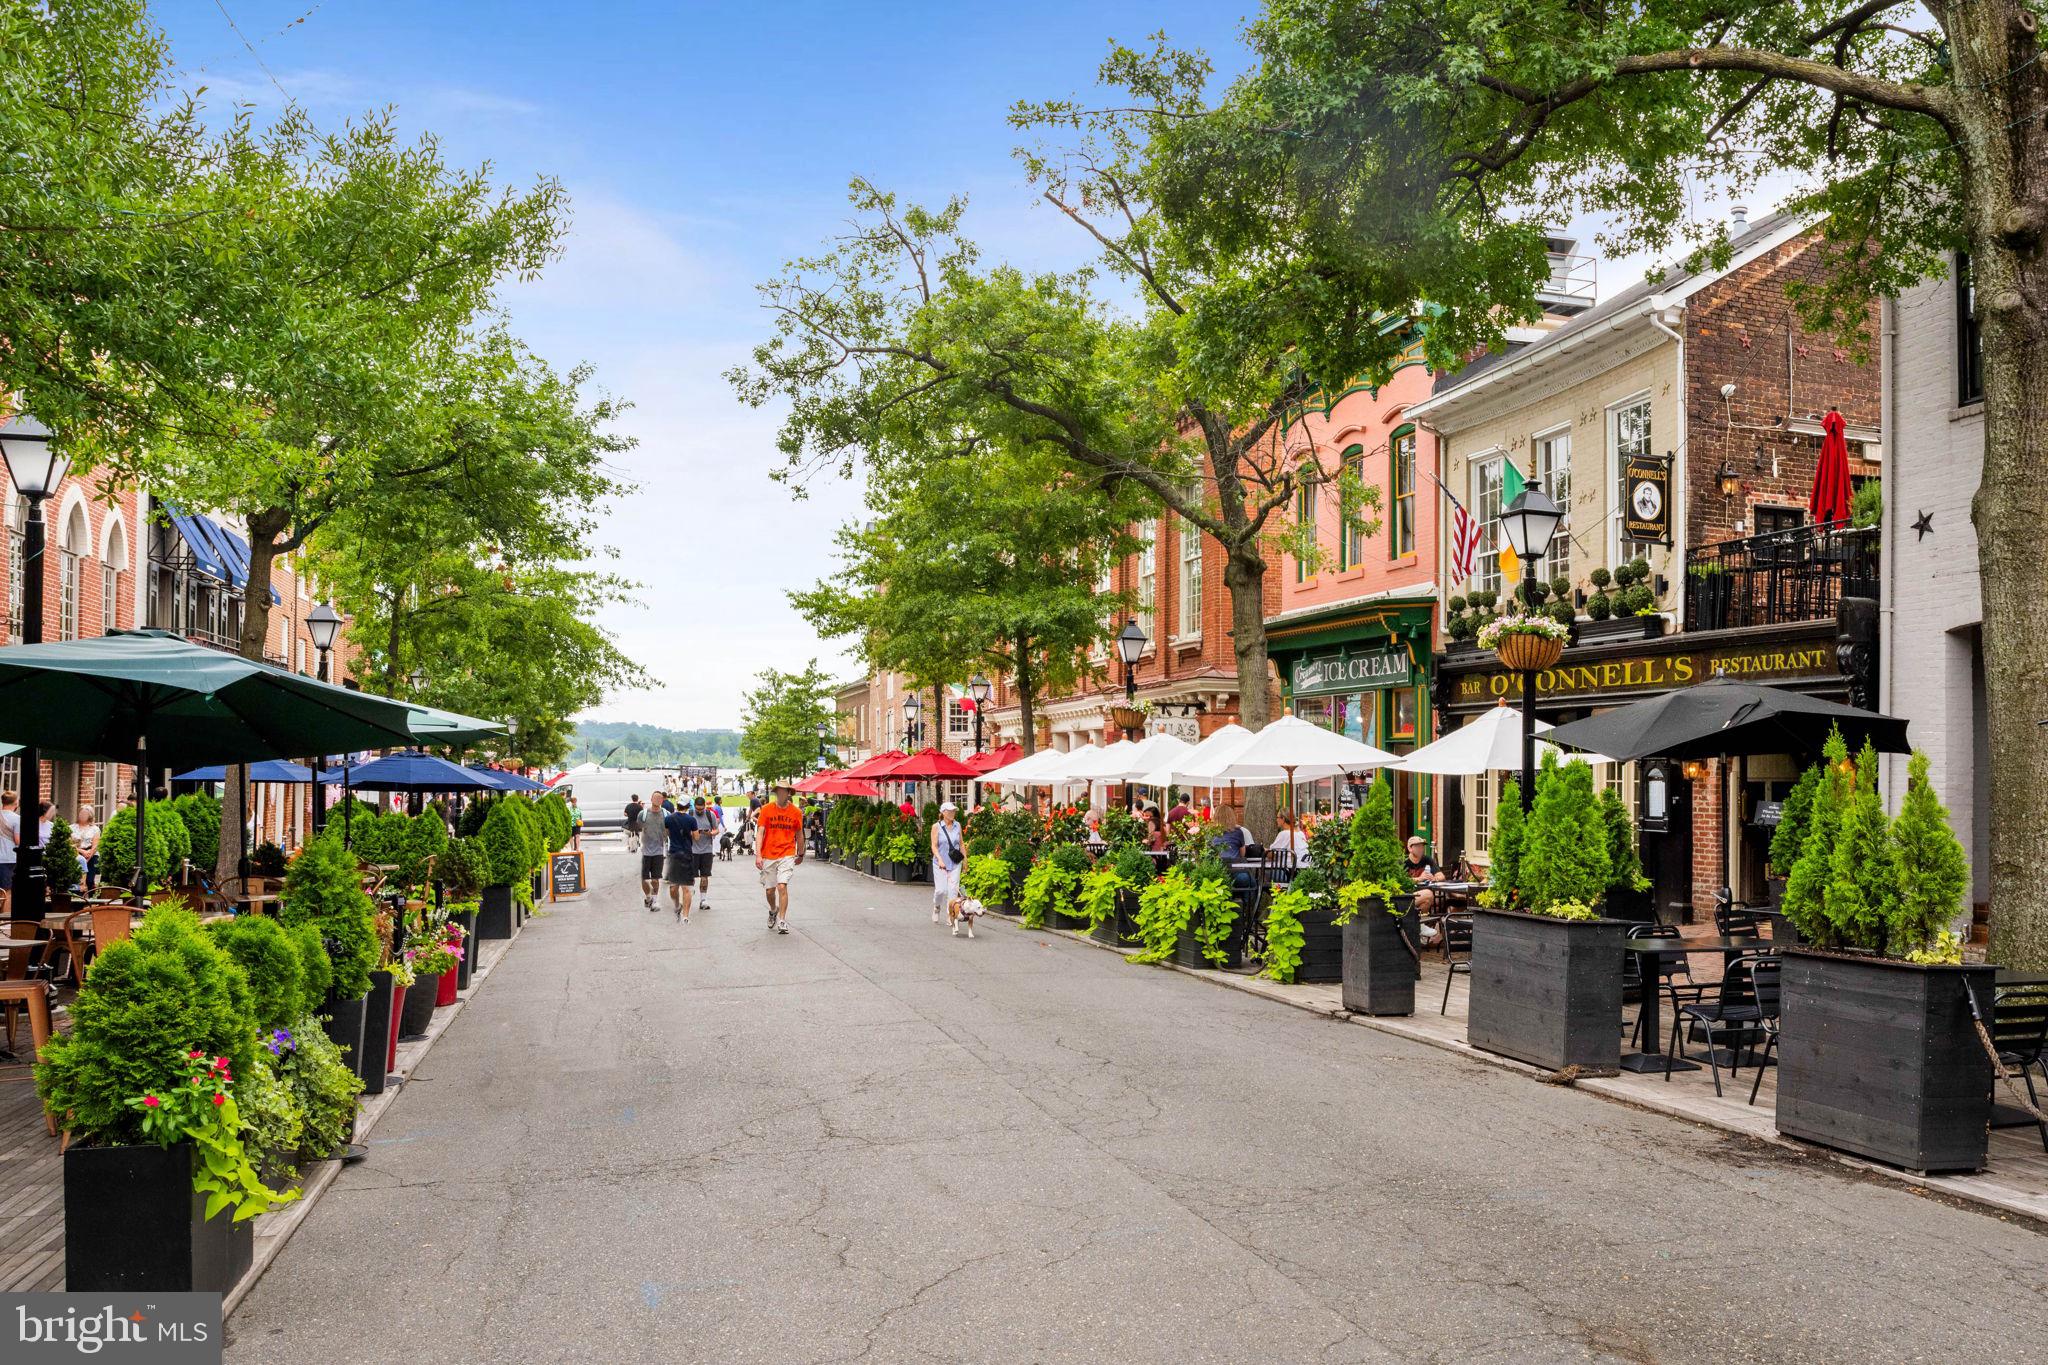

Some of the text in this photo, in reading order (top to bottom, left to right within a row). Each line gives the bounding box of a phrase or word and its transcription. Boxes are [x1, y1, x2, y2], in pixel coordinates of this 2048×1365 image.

[1629, 521, 1665, 532] RESTAURANT
[1323, 661, 1348, 682] ICE
[1348, 652, 1407, 680] CREAM
[1461, 681, 1481, 695] BAR
[1710, 649, 1826, 675] RESTAURANT
